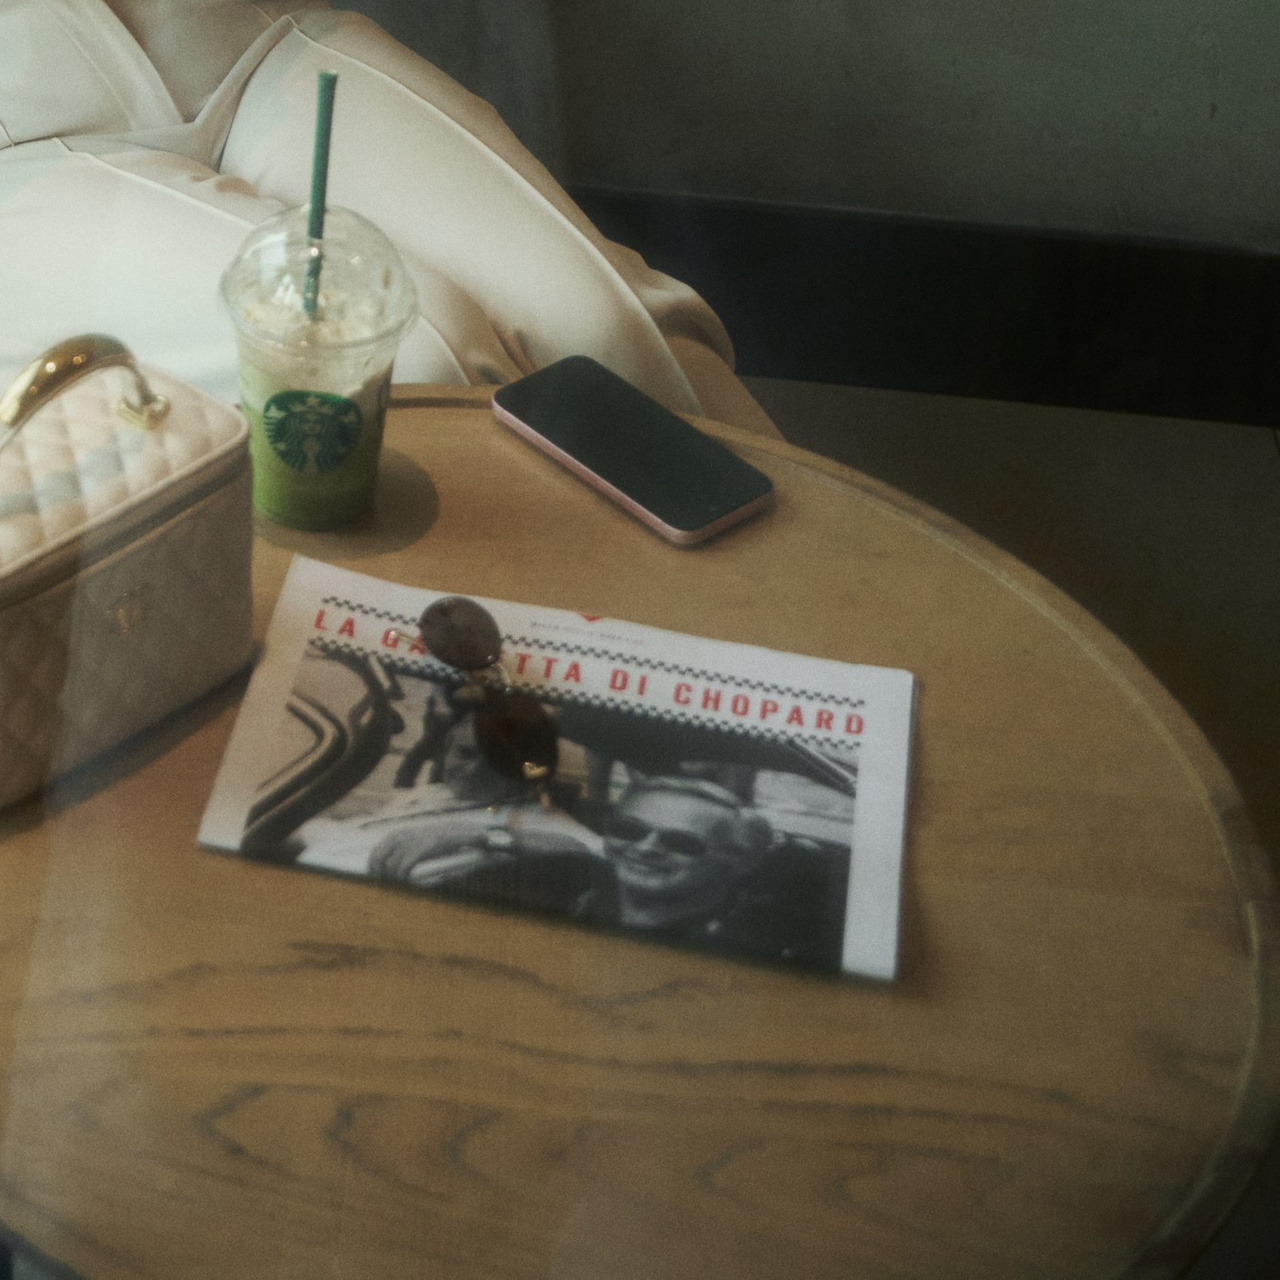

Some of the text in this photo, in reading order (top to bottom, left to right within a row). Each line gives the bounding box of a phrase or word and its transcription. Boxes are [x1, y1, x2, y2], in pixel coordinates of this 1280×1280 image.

[313, 609, 356, 639] LA
[381, 627, 581, 684] GATTA
[608, 668, 648, 696] DI
[673, 682, 865, 735] CHOPARD
